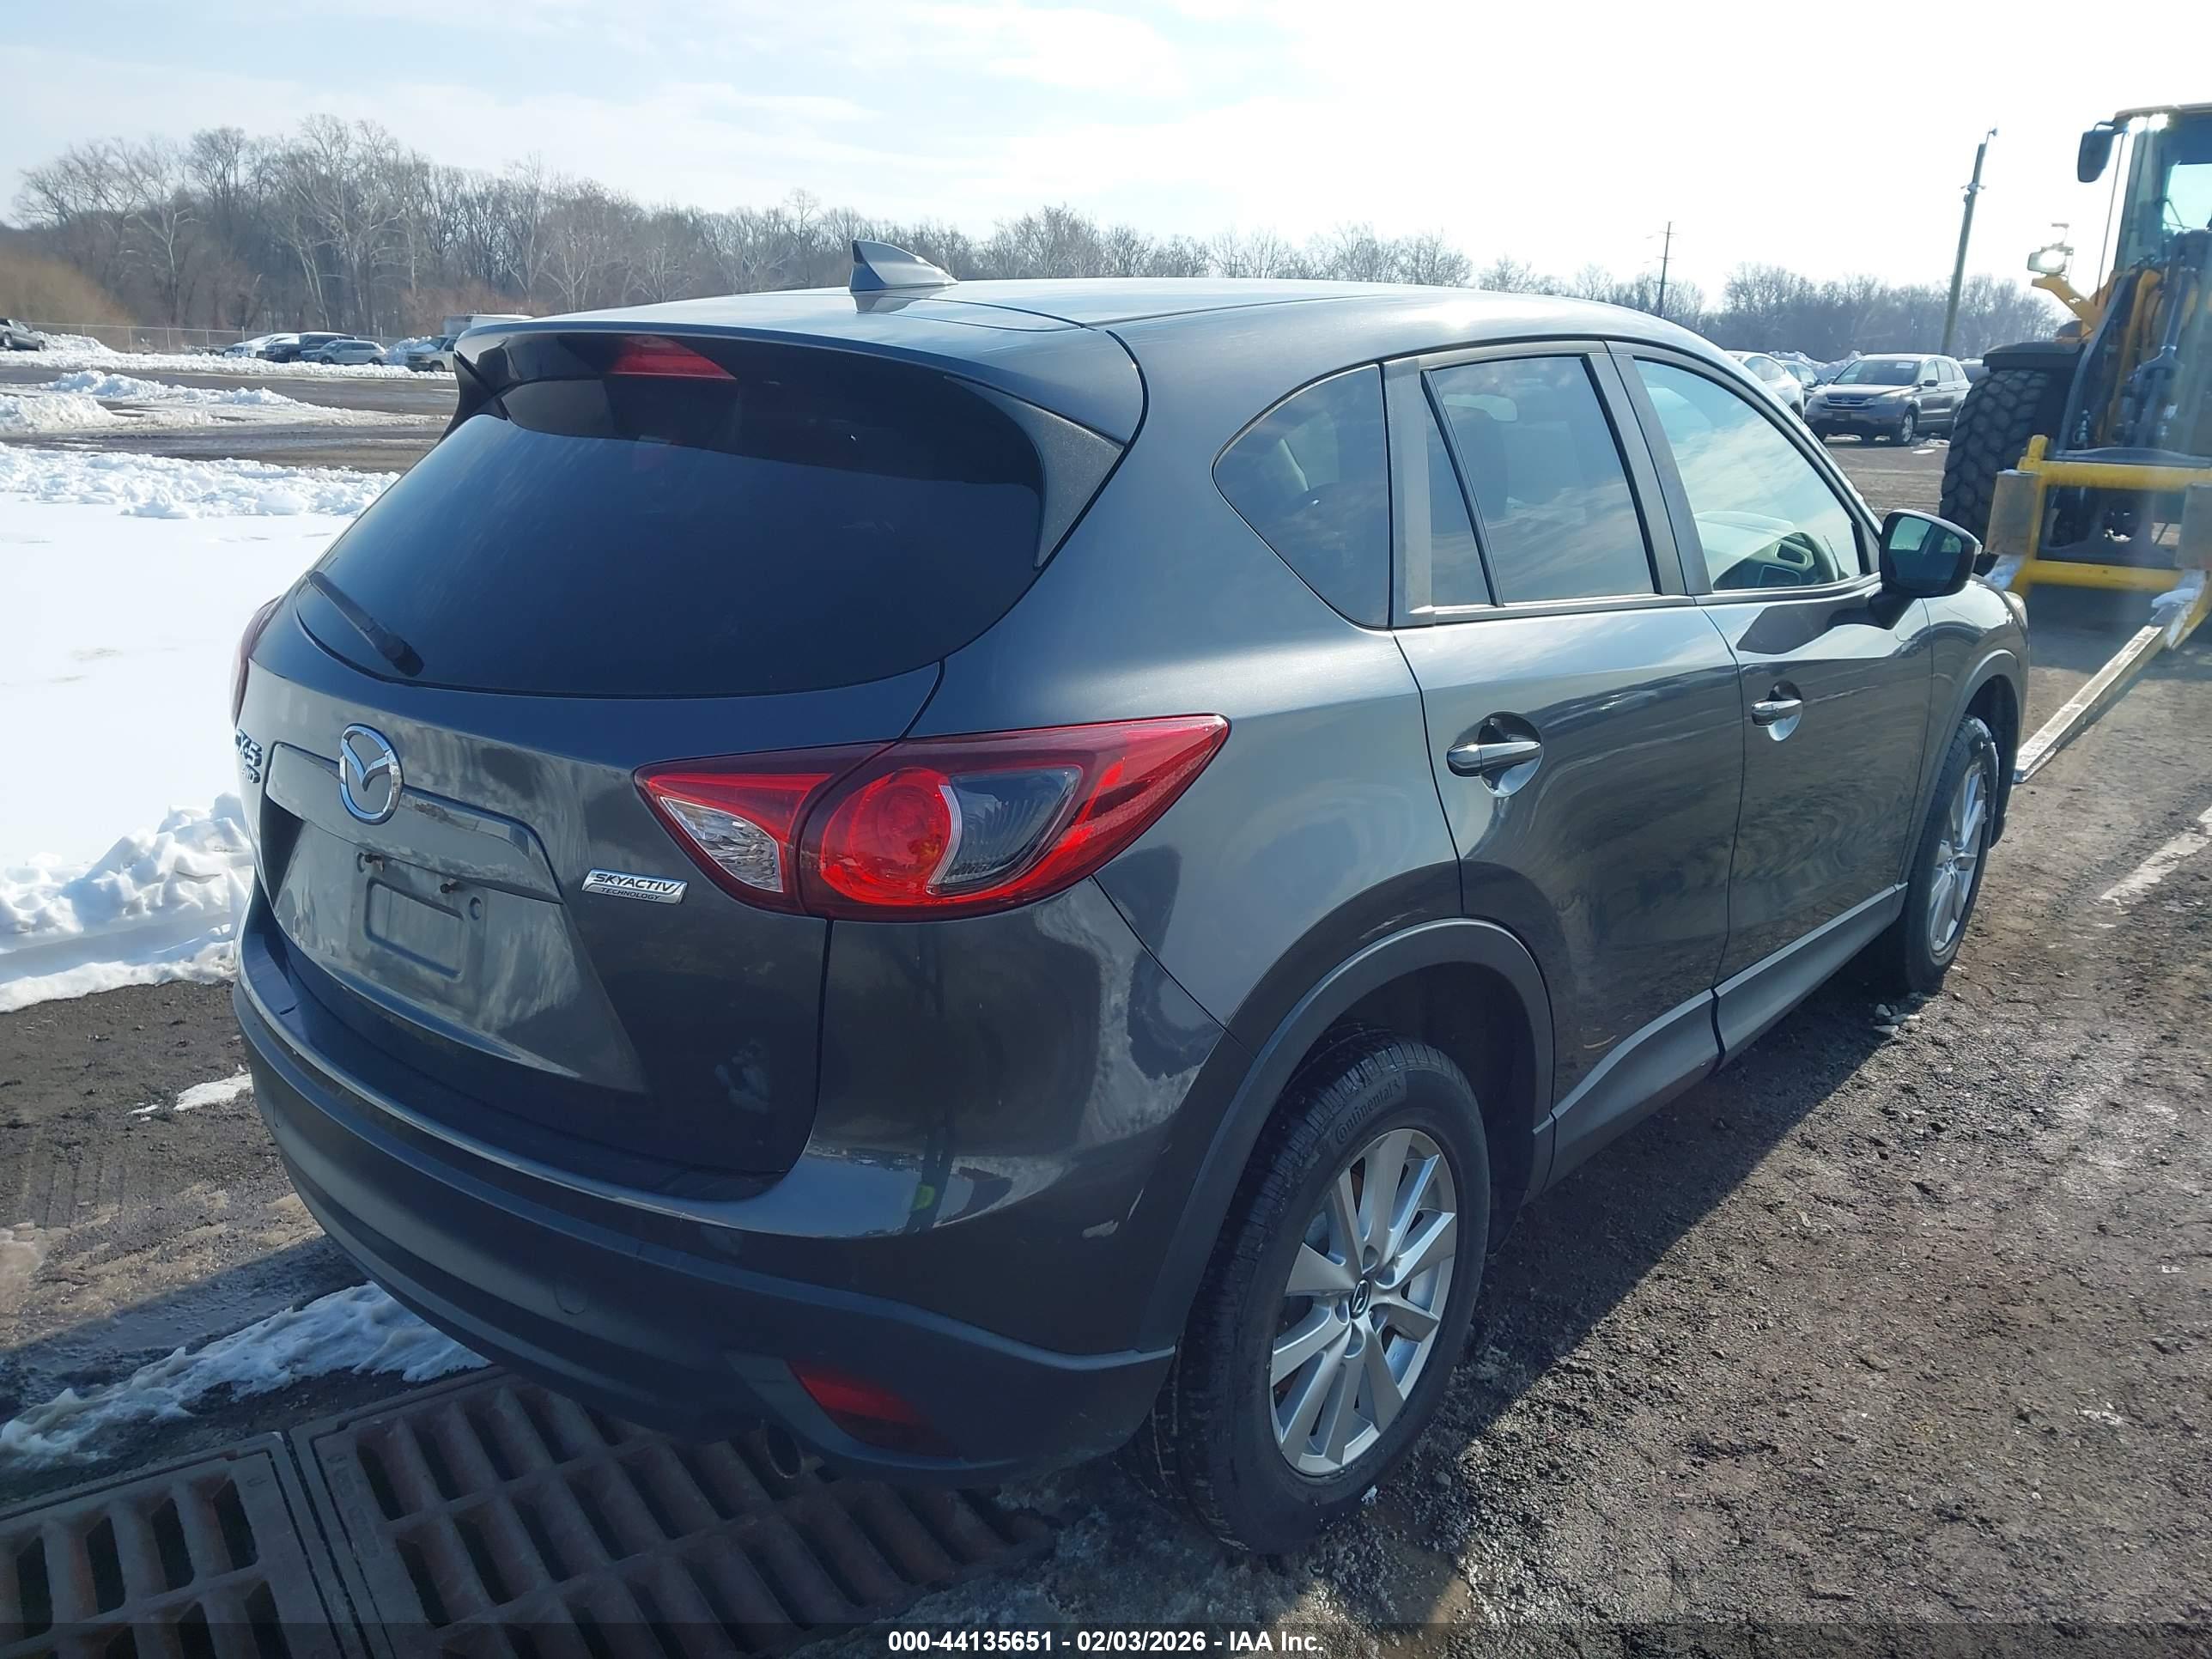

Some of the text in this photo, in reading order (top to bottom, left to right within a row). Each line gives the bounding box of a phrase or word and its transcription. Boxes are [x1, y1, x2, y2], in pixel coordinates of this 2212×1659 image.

[593, 873, 675, 892] SKYACTIV
[600, 887, 661, 901] TECHNOLOGY
[1335, 1082, 1394, 1145] Continental
